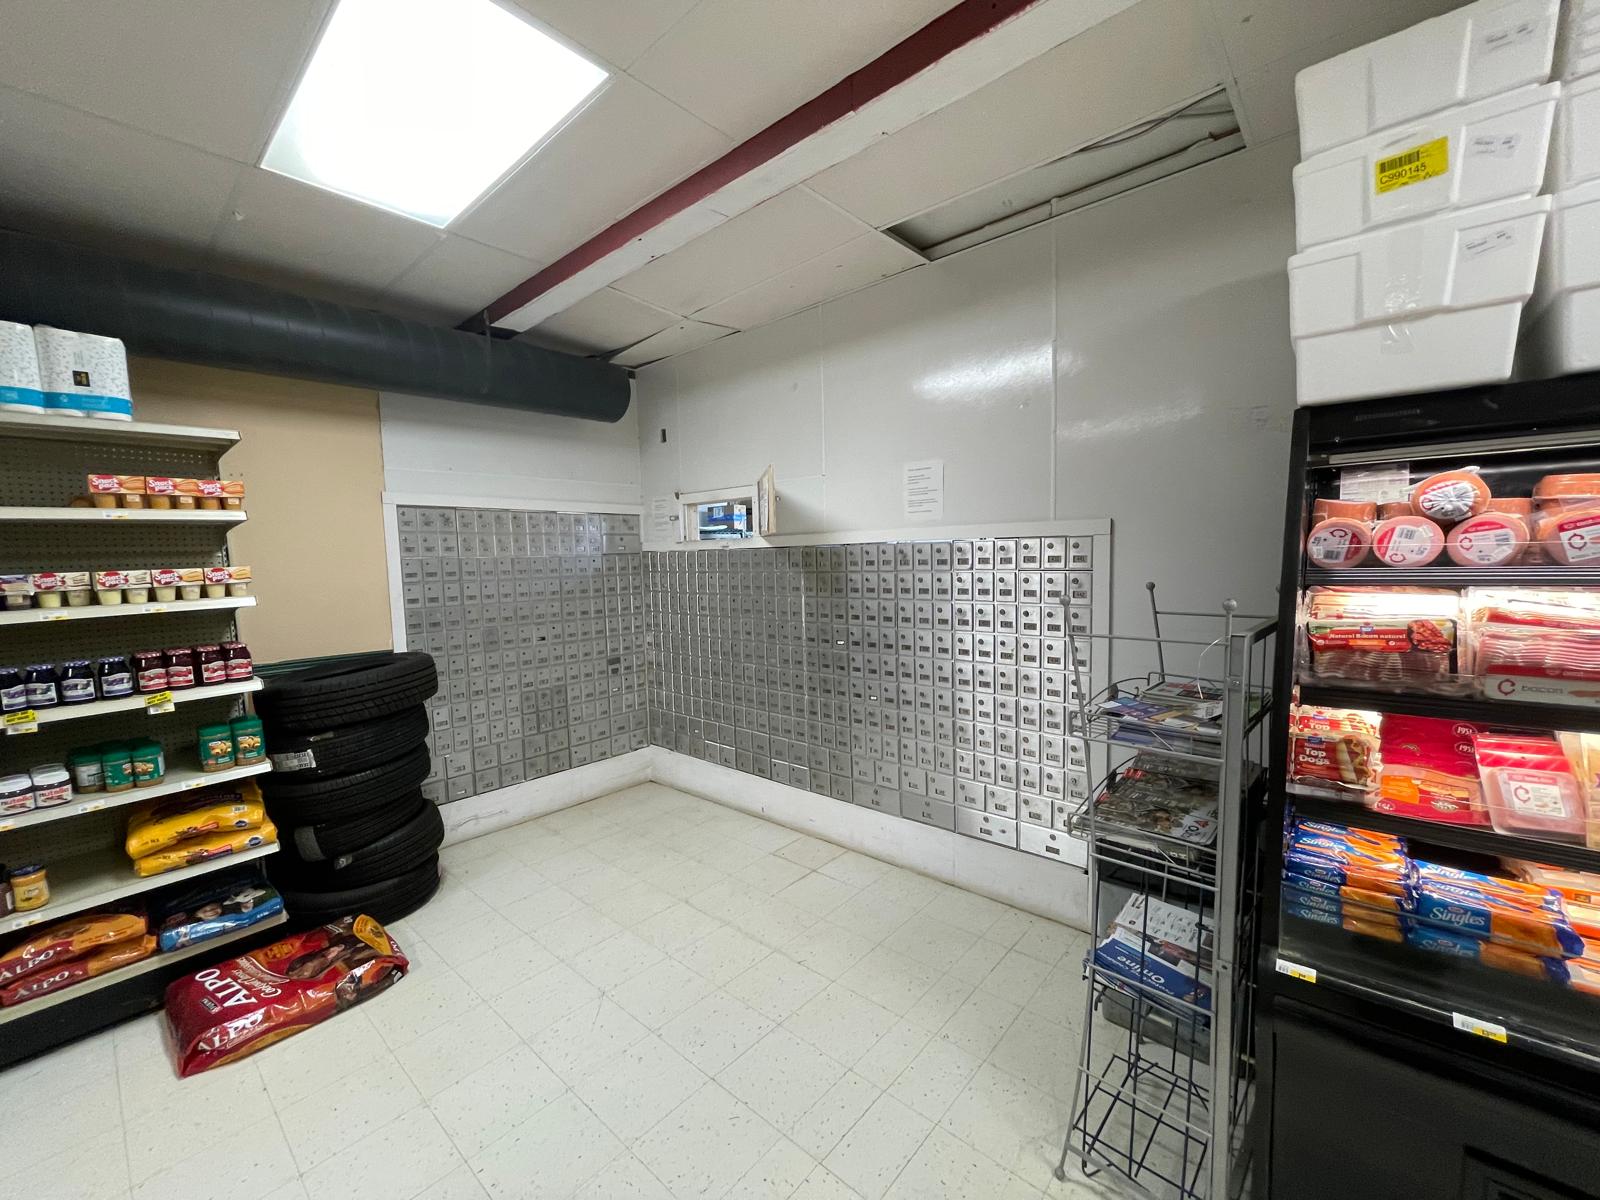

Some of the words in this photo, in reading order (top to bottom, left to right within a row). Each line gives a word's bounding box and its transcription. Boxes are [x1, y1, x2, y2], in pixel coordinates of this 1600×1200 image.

[1381, 162, 1427, 184] C990145
[1299, 754, 1330, 766] Dogs
[1304, 747, 1327, 757] Top
[39, 787, 70, 798] nutella
[1299, 896, 1337, 911] Singles
[1300, 909, 1338, 924] Singles
[1429, 906, 1486, 926] Singles
[0, 949, 54, 981] ALPO
[14, 970, 70, 1000] ALPO
[195, 968, 258, 1008] ALPO
